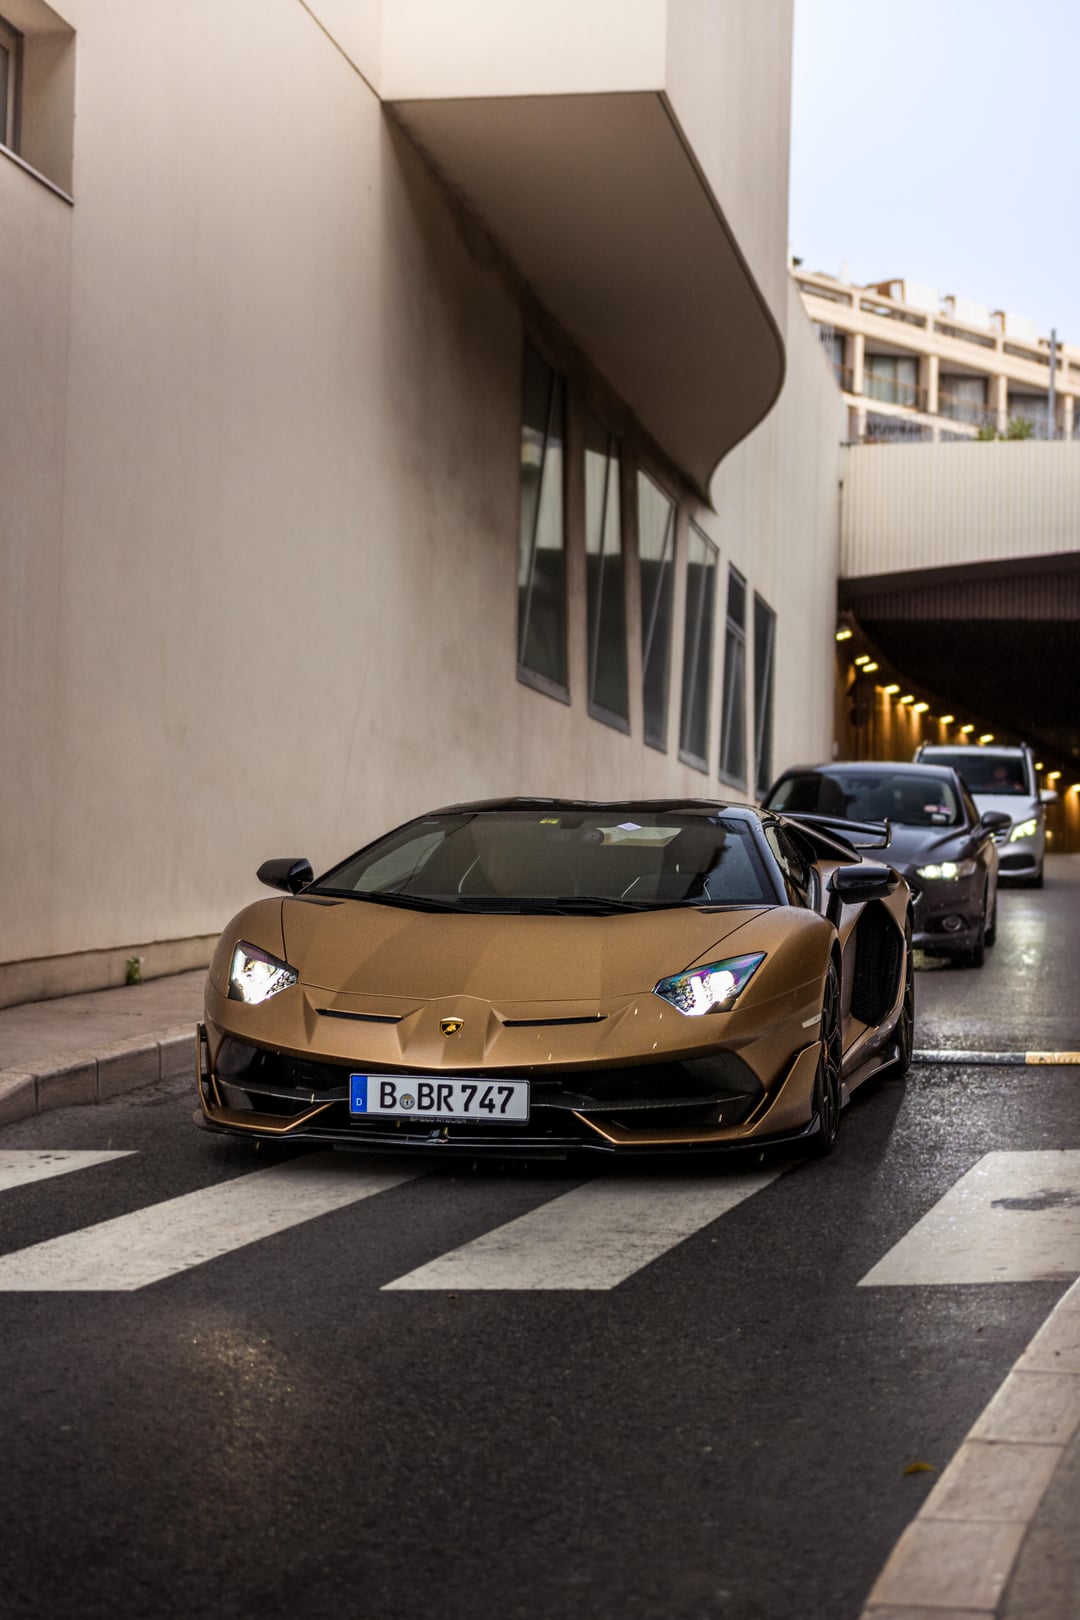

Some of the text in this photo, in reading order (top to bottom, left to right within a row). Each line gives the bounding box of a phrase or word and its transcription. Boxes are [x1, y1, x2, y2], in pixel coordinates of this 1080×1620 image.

[356, 1098, 363, 1106] D
[380, 1081, 515, 1114] B BR 747
